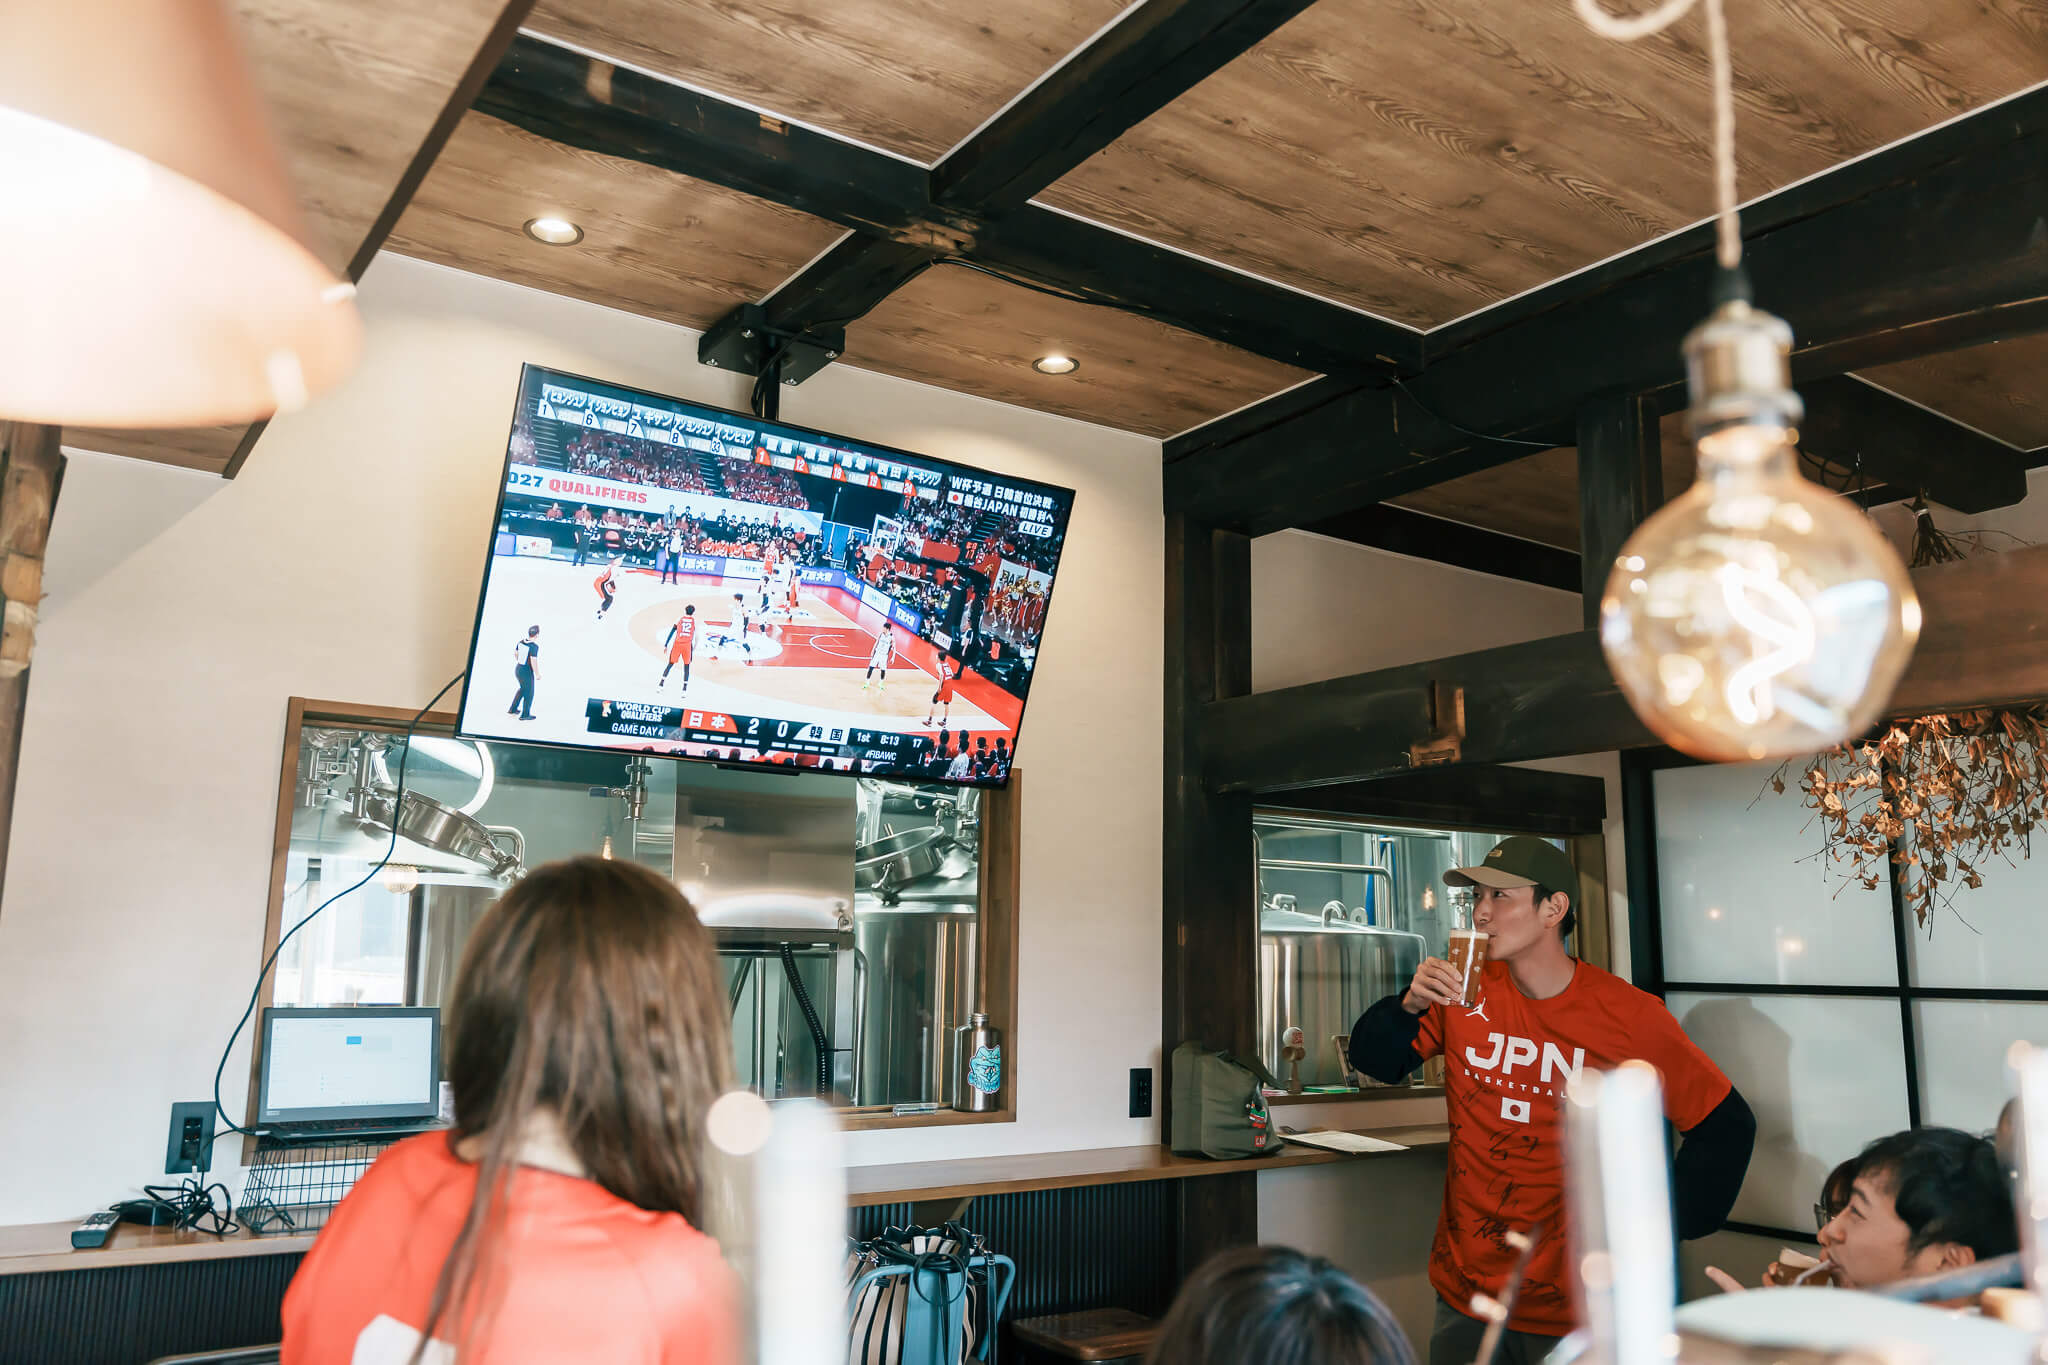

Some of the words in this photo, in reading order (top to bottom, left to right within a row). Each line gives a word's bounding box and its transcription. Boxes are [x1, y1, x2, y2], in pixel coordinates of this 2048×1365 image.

[585, 413, 593, 425] 6
[630, 423, 638, 434] 7
[672, 433, 679, 444] 8
[796, 460, 804, 471] 12
[549, 478, 648, 504] QUALIFIERS
[1022, 523, 1049, 536] LIVE
[616, 701, 650, 713] WORLD
[651, 705, 671, 715] CUP
[620, 711, 662, 723] QUALIFIERS
[688, 711, 727, 729] 日本
[611, 722, 638, 735] GAME
[639, 725, 658, 737] DAY
[748, 717, 760, 735] 2
[777, 721, 789, 738] 0
[857, 732, 871, 743] 1st
[912, 738, 922, 749] 17
[1465, 1031, 1585, 1083] JPN
[1464, 1068, 1568, 1099] BASKETBAL
